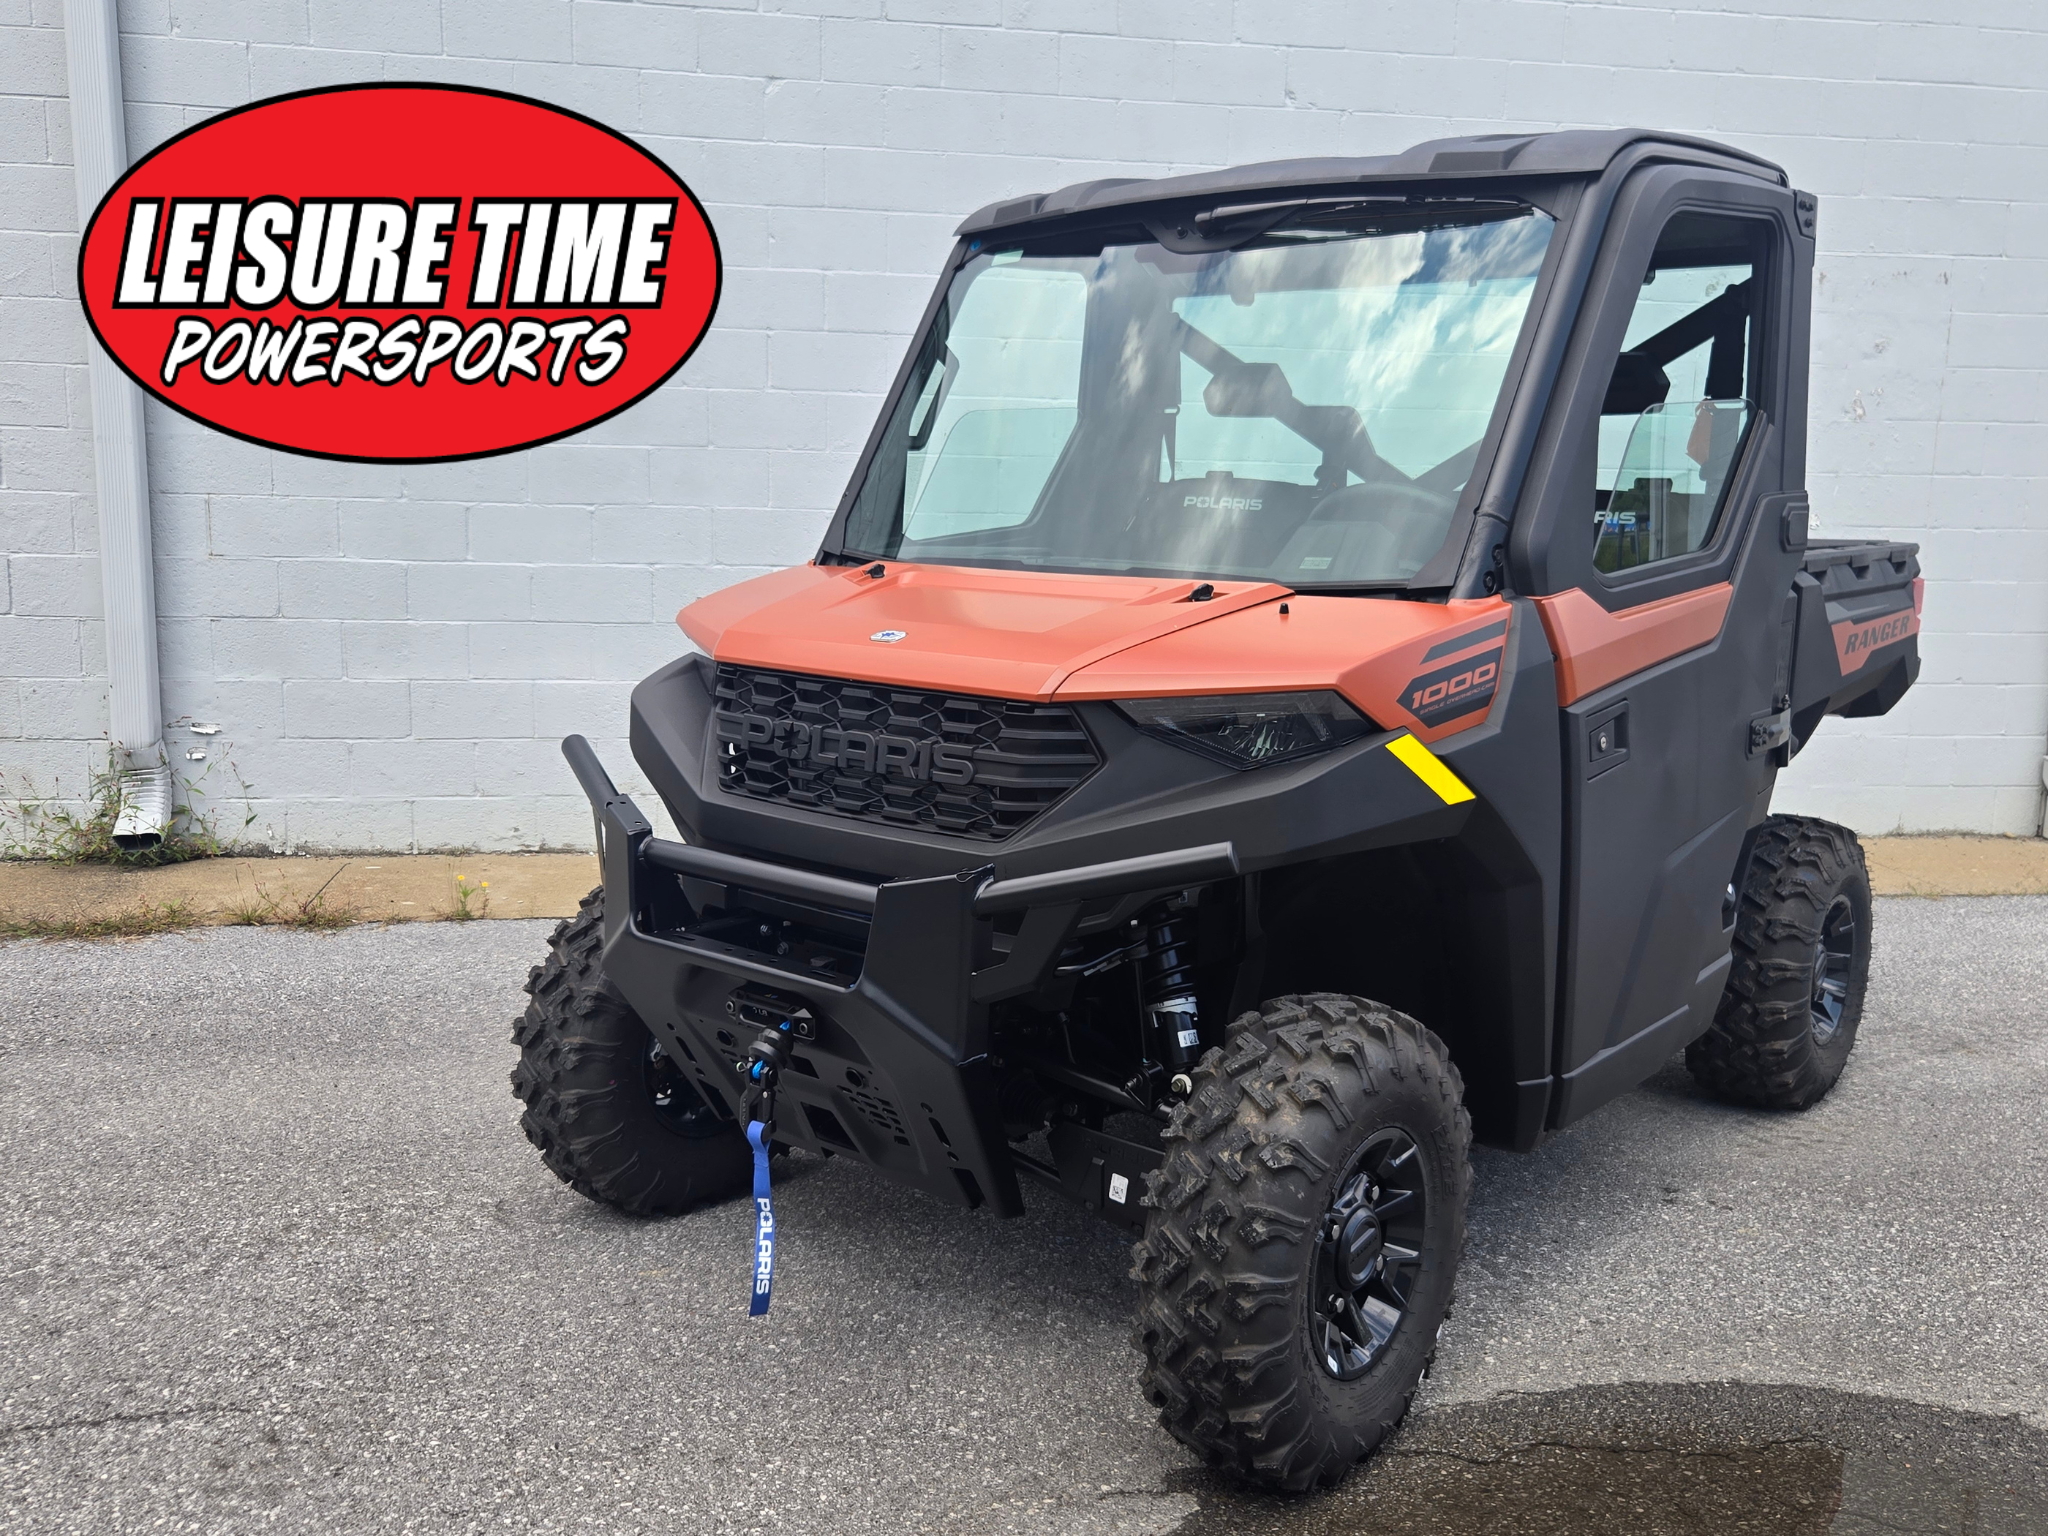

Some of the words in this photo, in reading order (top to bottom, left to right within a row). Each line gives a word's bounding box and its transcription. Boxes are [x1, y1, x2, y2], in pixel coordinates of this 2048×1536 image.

[1183, 496, 1263, 511] POLARIS
[1843, 615, 1910, 656] RANGER
[1412, 662, 1496, 709] 1000
[741, 713, 977, 785] POLARIS
[756, 1197, 773, 1295] POLARIS
